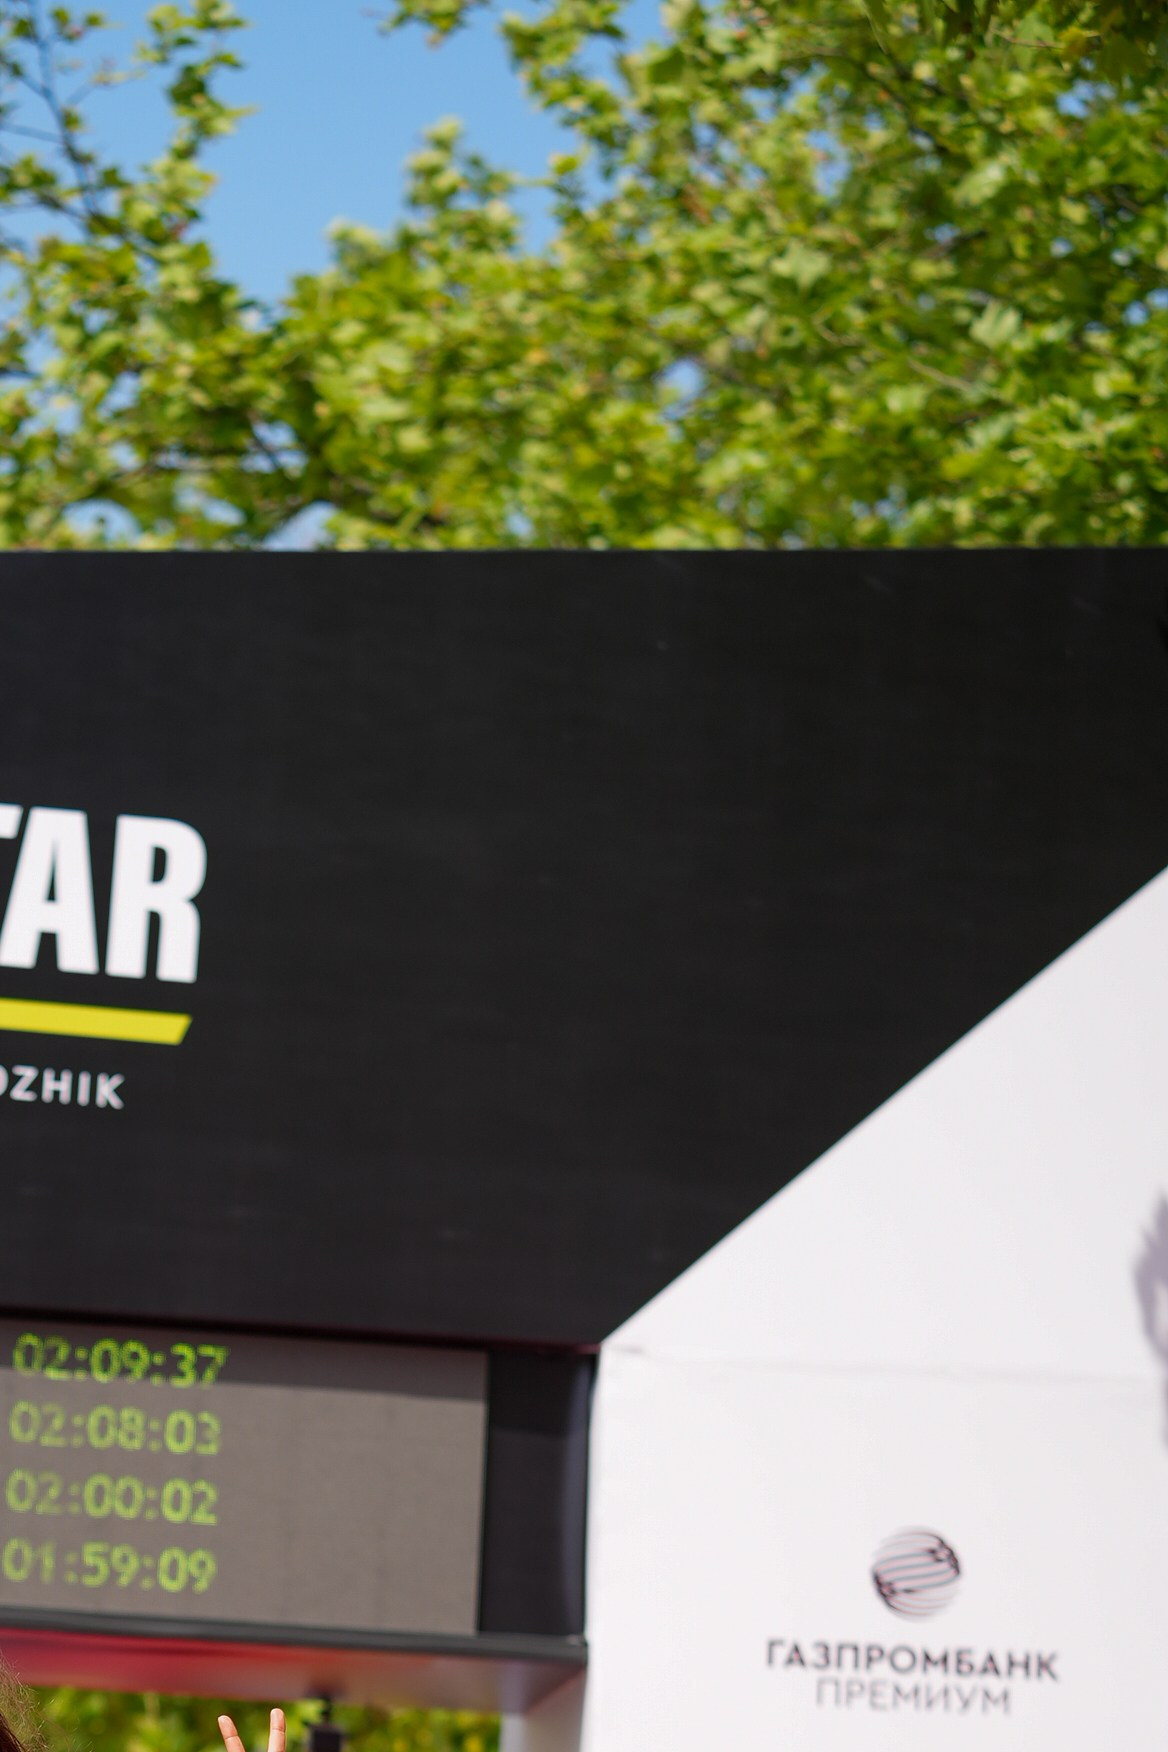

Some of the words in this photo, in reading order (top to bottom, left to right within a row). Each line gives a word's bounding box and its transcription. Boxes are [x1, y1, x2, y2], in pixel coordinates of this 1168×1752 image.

[12, 1333, 228, 1388] 02:09:37
[9, 1400, 221, 1455] 02:08:03
[5, 1468, 218, 1526] 02:00:02
[1, 1537, 217, 1594] 01:59:09
[767, 1638, 1059, 1681] ГАЗПРОМБАНК
[816, 1676, 1010, 1714] ПРЕМИУМ
